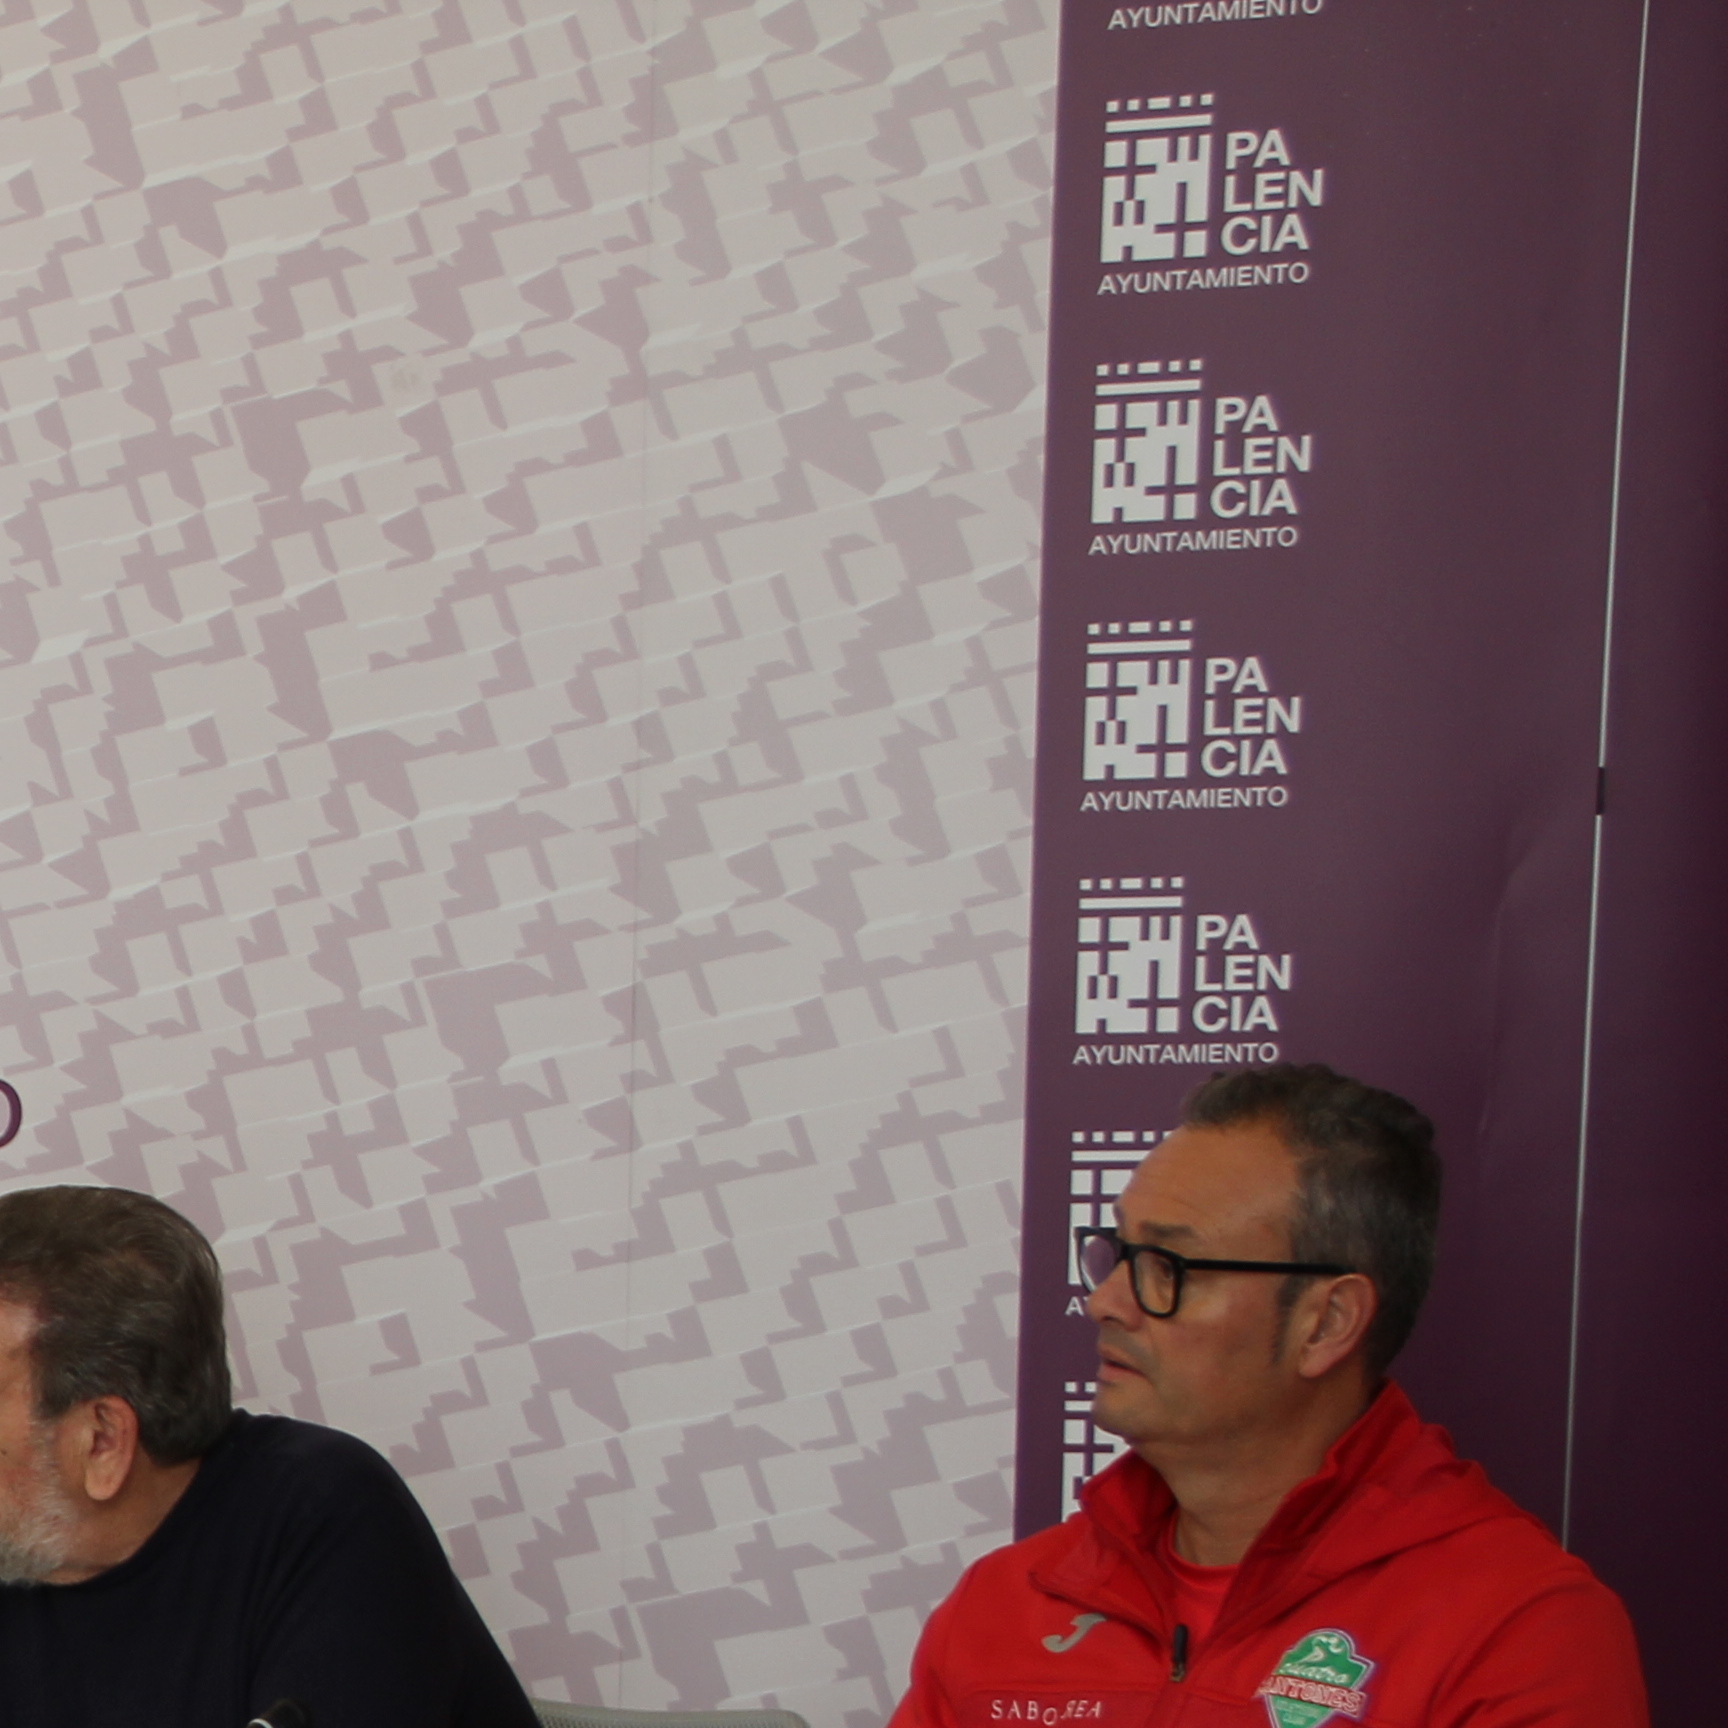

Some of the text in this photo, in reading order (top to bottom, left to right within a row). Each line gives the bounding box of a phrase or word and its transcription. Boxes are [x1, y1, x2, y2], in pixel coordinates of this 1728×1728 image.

[1108, 0, 1323, 30] AYUNTAMIENTO
[1225, 129, 1291, 170] PA
[1223, 169, 1323, 213] LEN
[1220, 213, 1310, 256] CIA
[1097, 262, 1310, 296] AYUNTAMIENTO
[1214, 396, 1279, 434] PA
[1212, 435, 1312, 477] LEN
[1209, 479, 1298, 520] CIA
[1088, 527, 1298, 556] AYUNTAMIENTO
[1204, 656, 1268, 695] PA
[1202, 697, 1301, 736] LEN
[1200, 740, 1288, 776] CIA
[1080, 787, 1288, 812] AYUNTAMIENTO
[1195, 914, 1260, 950] PA
[1194, 955, 1292, 991] LEN
[1192, 996, 1279, 1033] CIA
[1073, 1043, 1279, 1066] AYUNTAMIENTO
